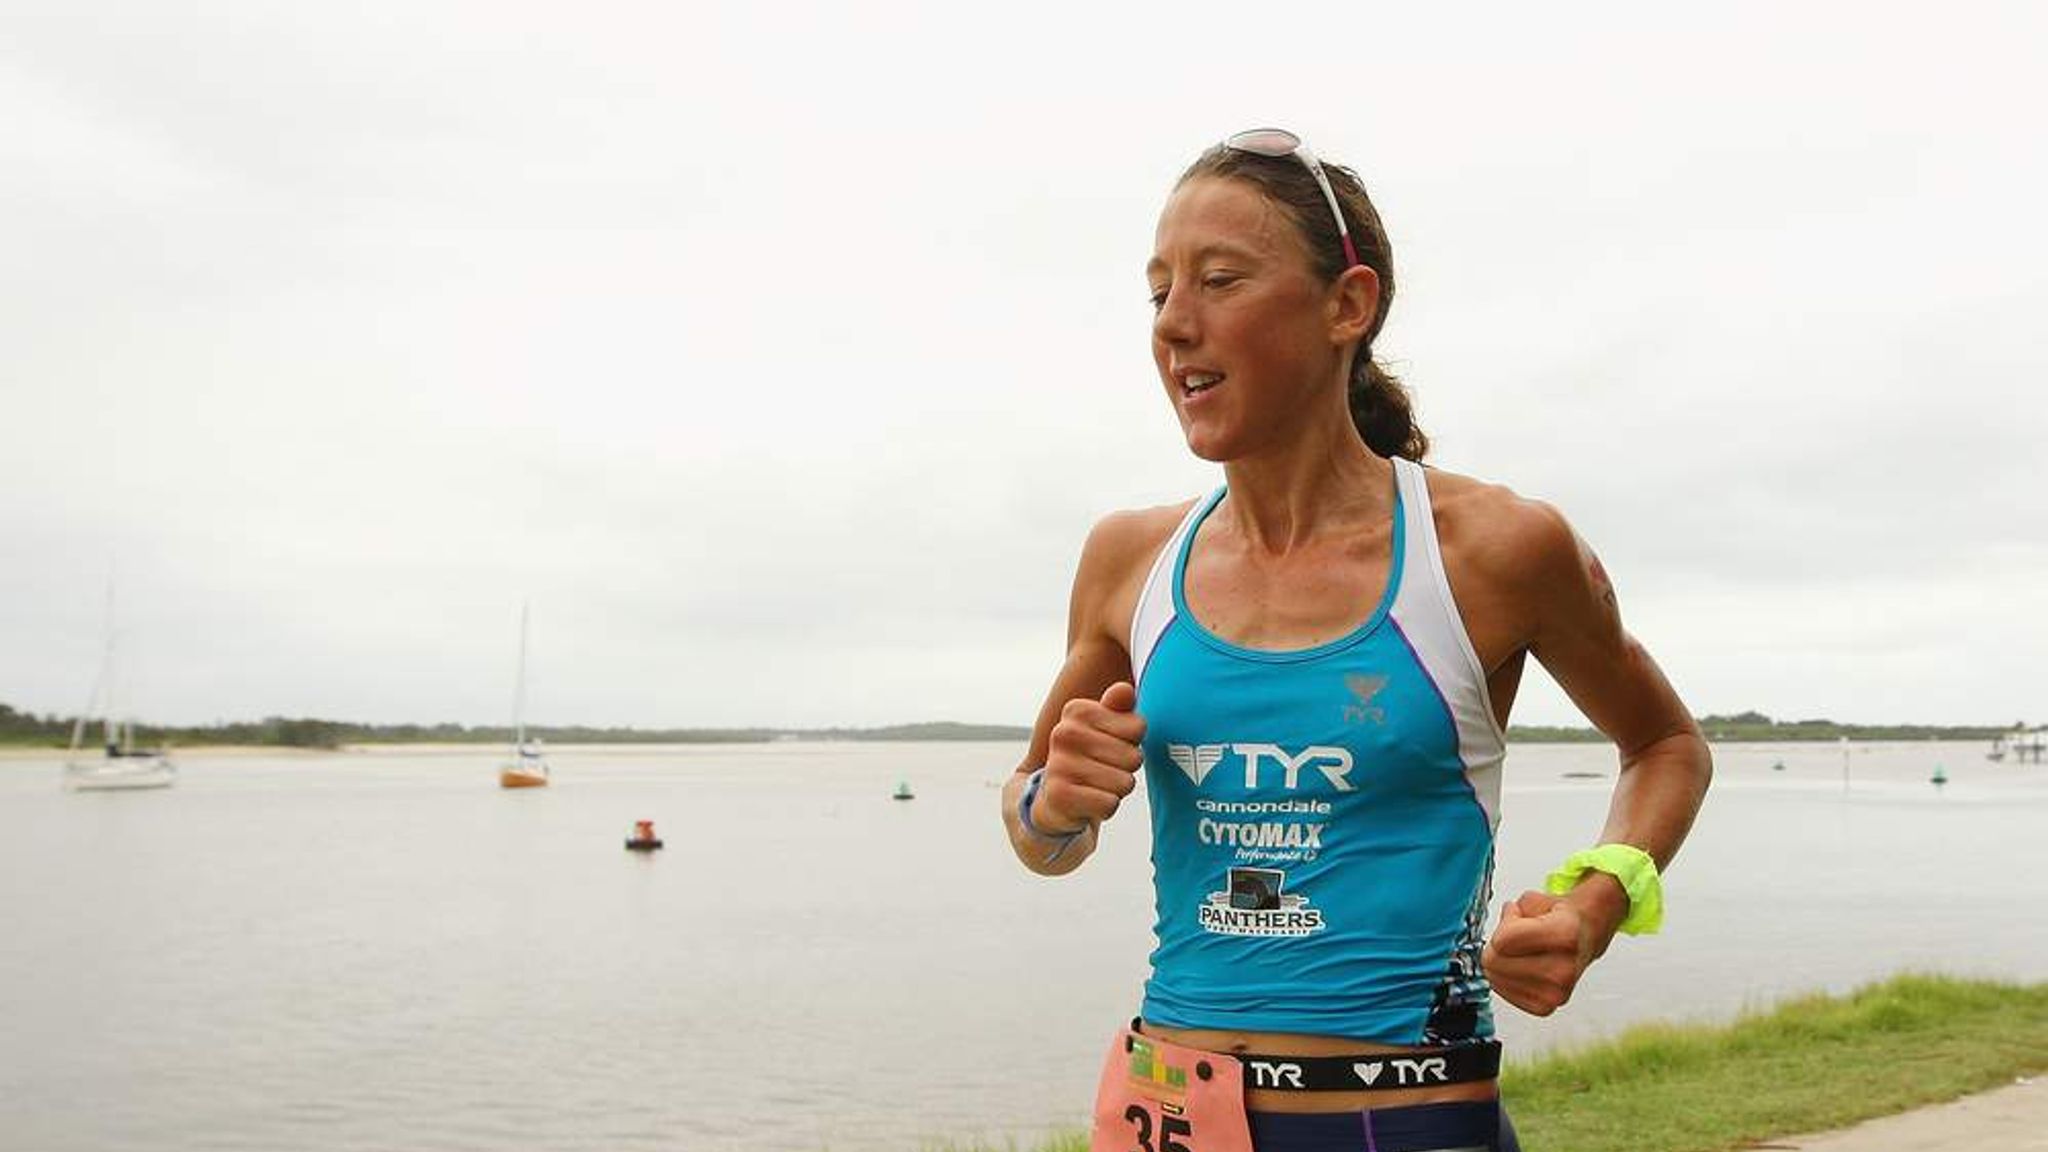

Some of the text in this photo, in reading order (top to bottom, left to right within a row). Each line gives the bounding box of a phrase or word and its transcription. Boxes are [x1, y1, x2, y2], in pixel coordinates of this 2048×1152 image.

[1232, 743, 1358, 791] TYR
[1199, 817, 1325, 849] CYTOMAX
[1201, 907, 1319, 928] PANTHERS
[1250, 1061, 1304, 1088] TYR
[1391, 1057, 1448, 1084] TYR
